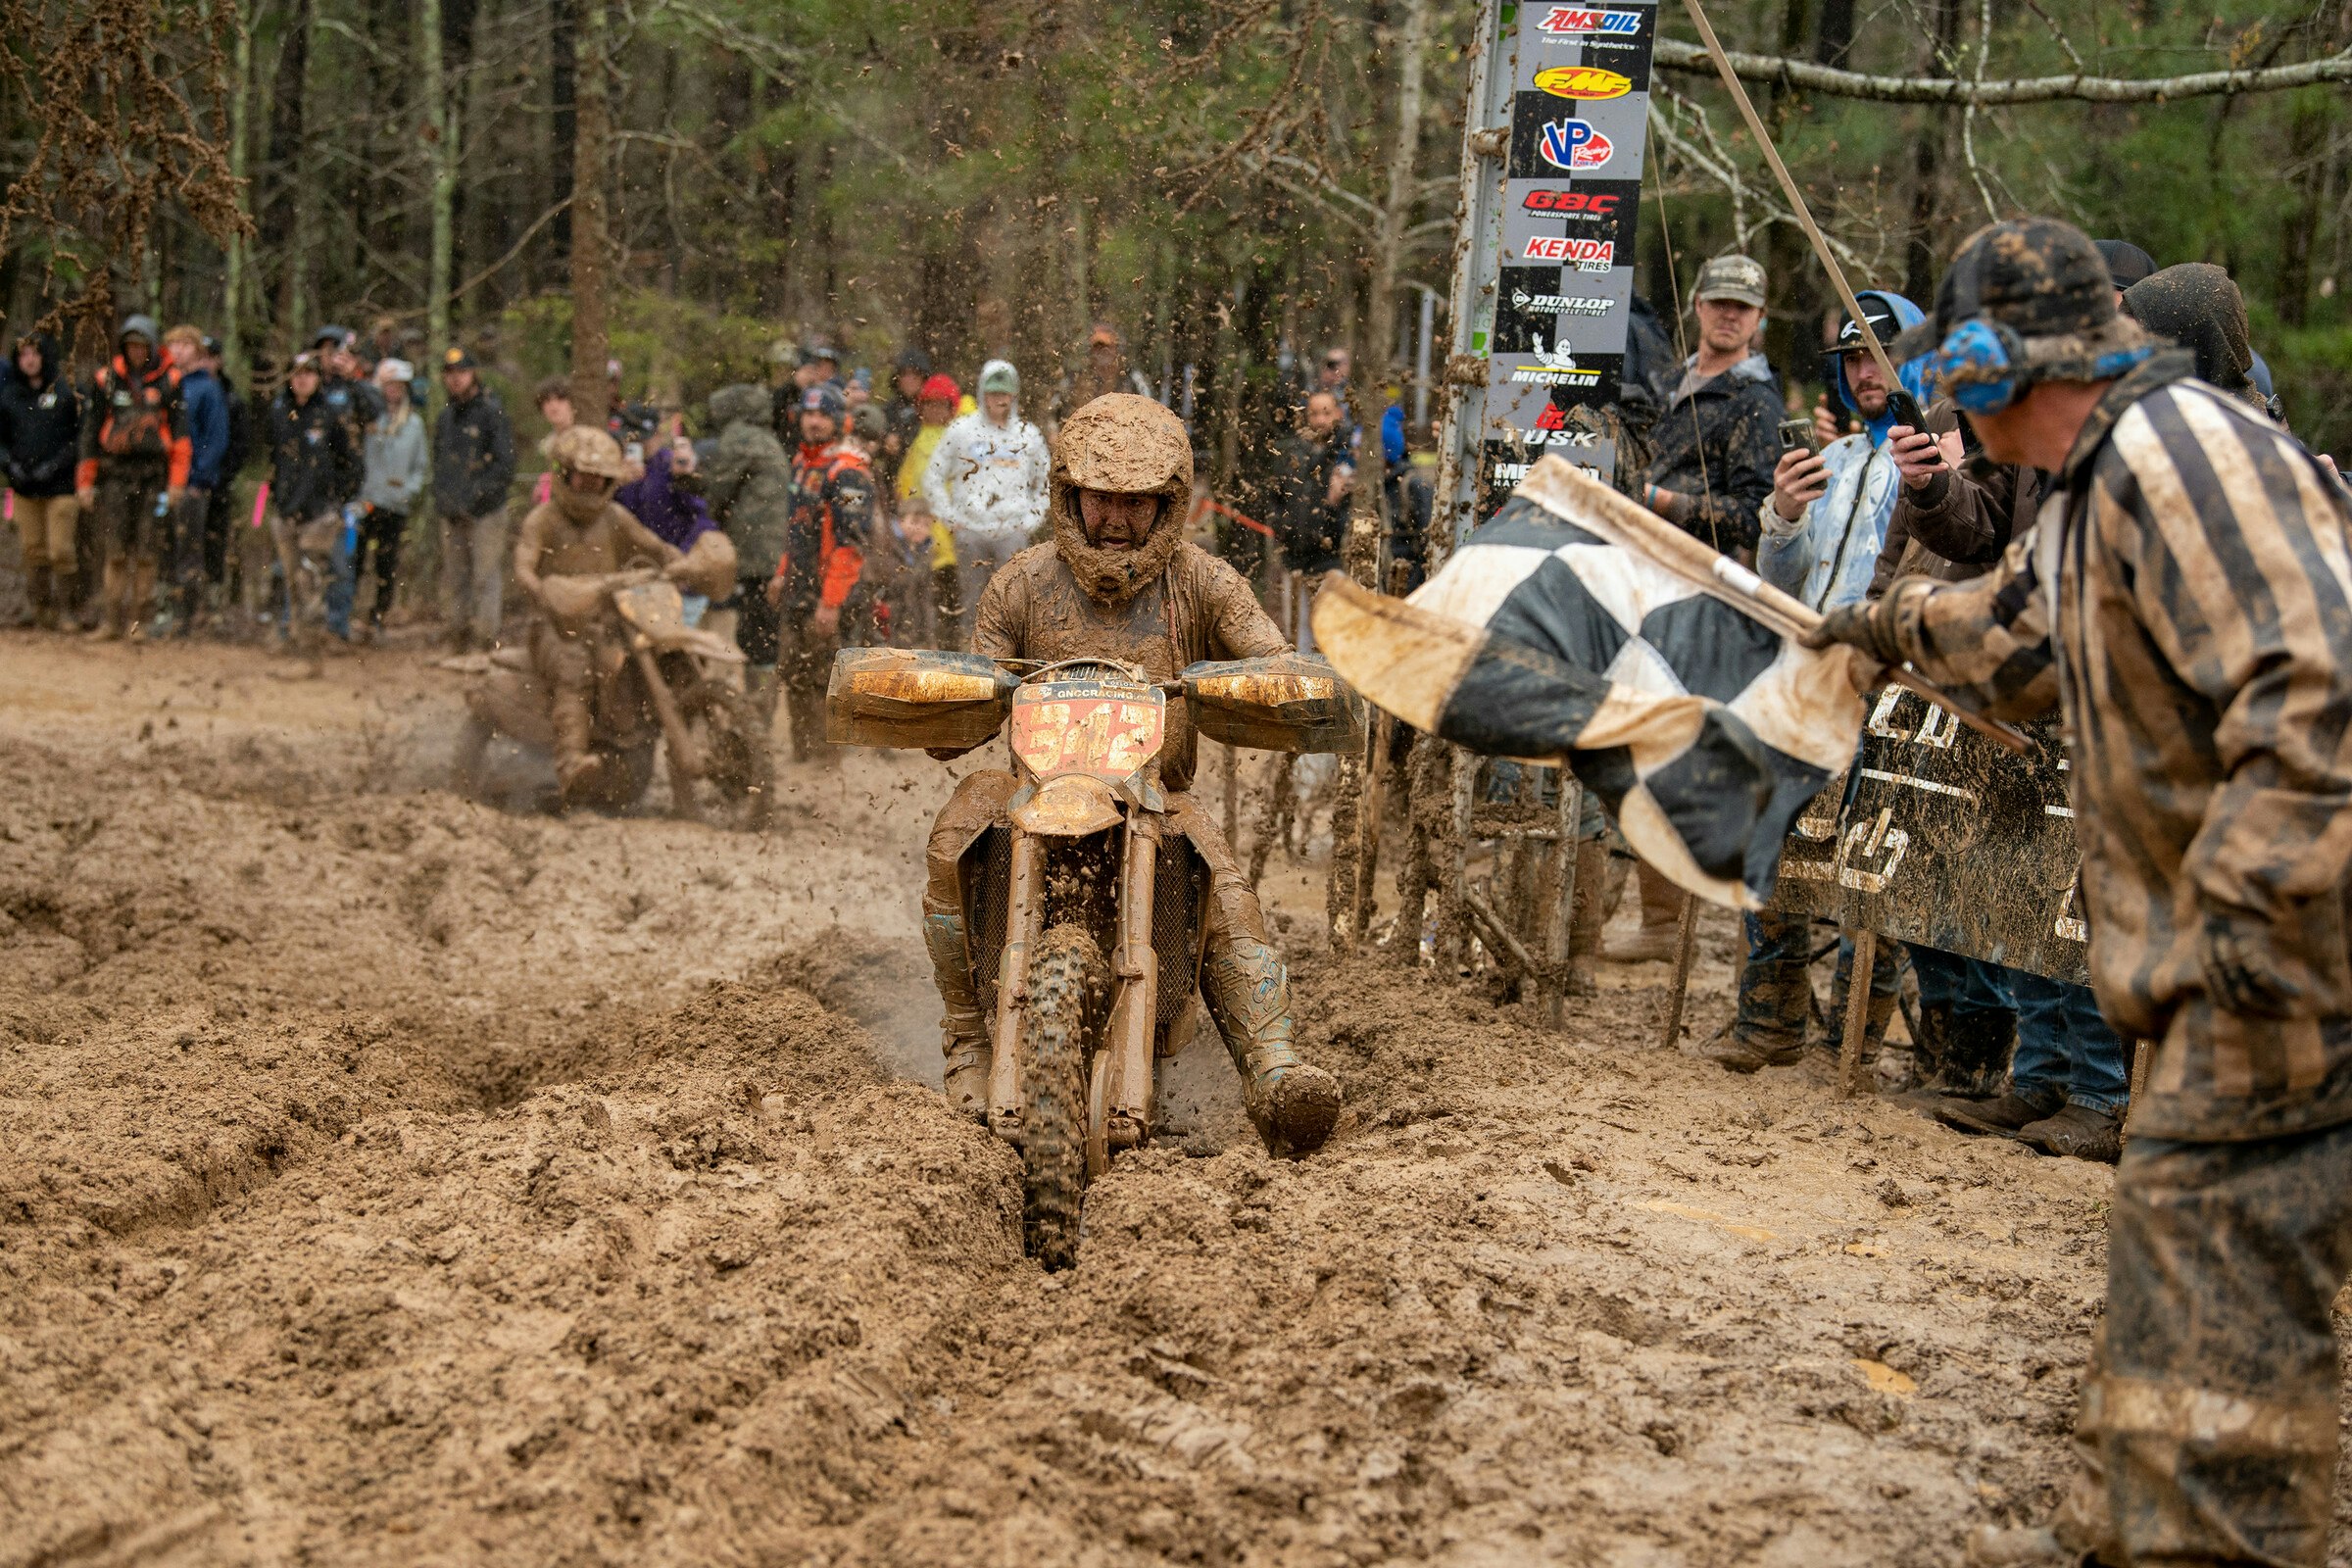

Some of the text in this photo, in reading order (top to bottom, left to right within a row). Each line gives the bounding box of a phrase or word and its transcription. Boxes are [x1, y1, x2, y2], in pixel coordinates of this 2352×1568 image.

[1542, 9, 1638, 32] AMSOIL
[1590, 40, 1636, 50] Synthetics
[1535, 71, 1632, 92] FMF
[1545, 122, 1592, 166] VP
[1524, 190, 1620, 213] GBC
[1531, 211, 1580, 220] POWERSPORTS
[1526, 238, 1612, 261] KENDA
[1578, 261, 1610, 271] TIRES
[1528, 306, 1581, 316] MOTORCYCLE
[1531, 295, 1615, 310] DUNLOP
[1511, 370, 1599, 387] MICHELIN
[1503, 428, 1597, 448] TUSK
[1022, 703, 1157, 772] 342
